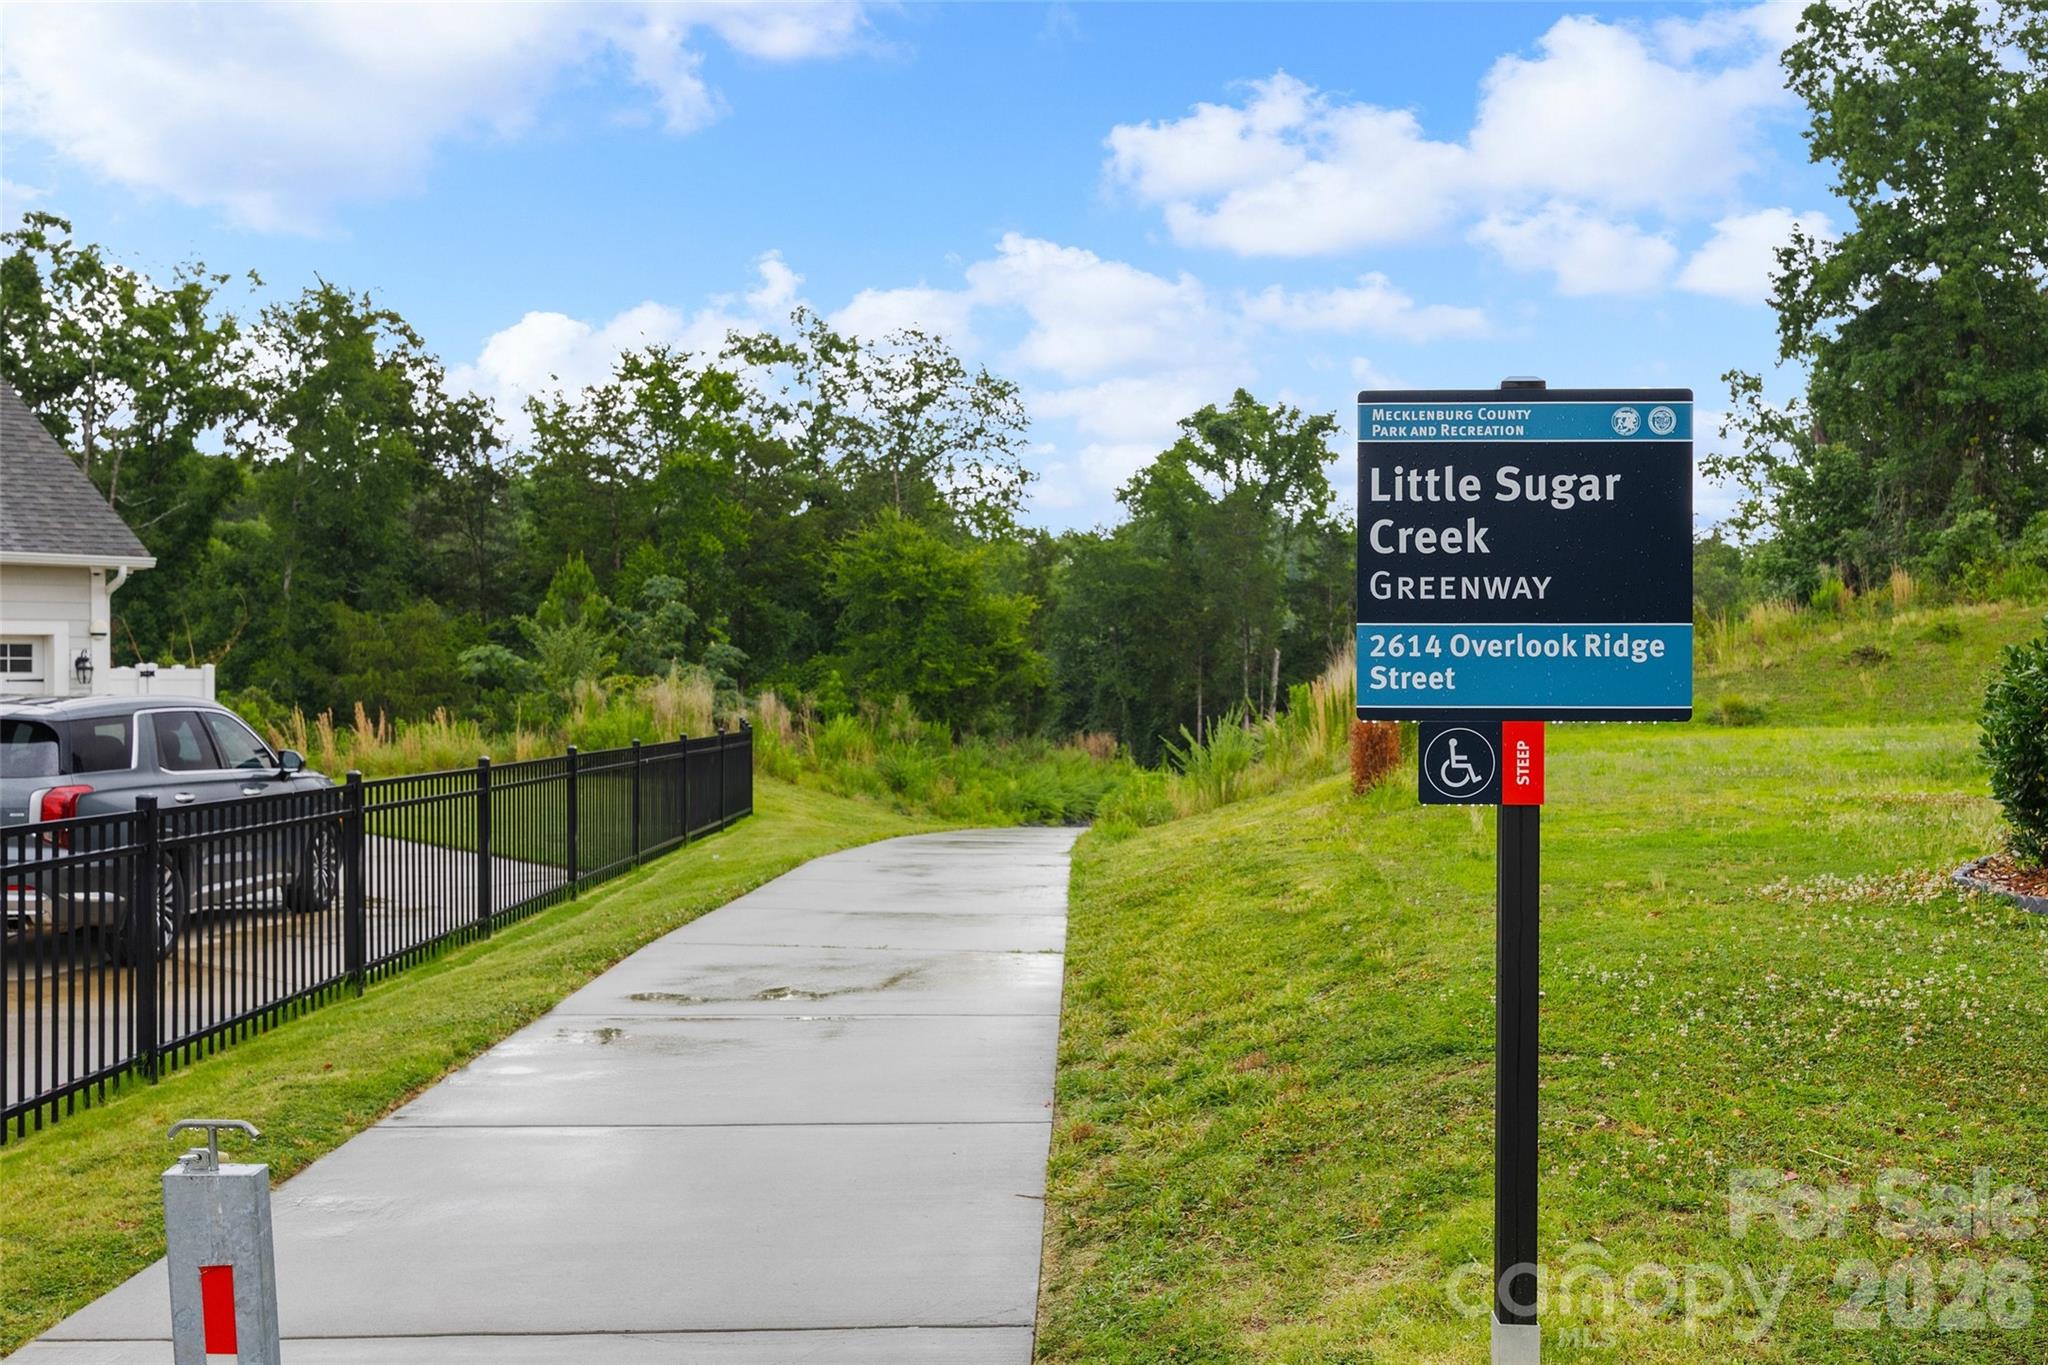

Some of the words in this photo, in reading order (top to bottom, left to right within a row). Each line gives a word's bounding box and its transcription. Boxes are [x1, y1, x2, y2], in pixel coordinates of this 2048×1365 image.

[1372, 408, 1473, 421] MECKLENBURG
[1477, 407, 1532, 421] COUNTY
[1372, 424, 1406, 437] PARK
[1410, 425, 1437, 437] AND
[1440, 423, 1524, 437] RECREATION
[1370, 465, 1481, 502] Little
[1495, 465, 1622, 510] Sugar
[1369, 517, 1491, 554] Creek
[1370, 570, 1552, 600] GREENWAY
[1369, 633, 1442, 658] 2614
[1450, 633, 1578, 658] Overlook
[1584, 633, 1665, 663] Ridge
[1369, 665, 1456, 690] Street
[1516, 740, 1530, 785] STEEP
